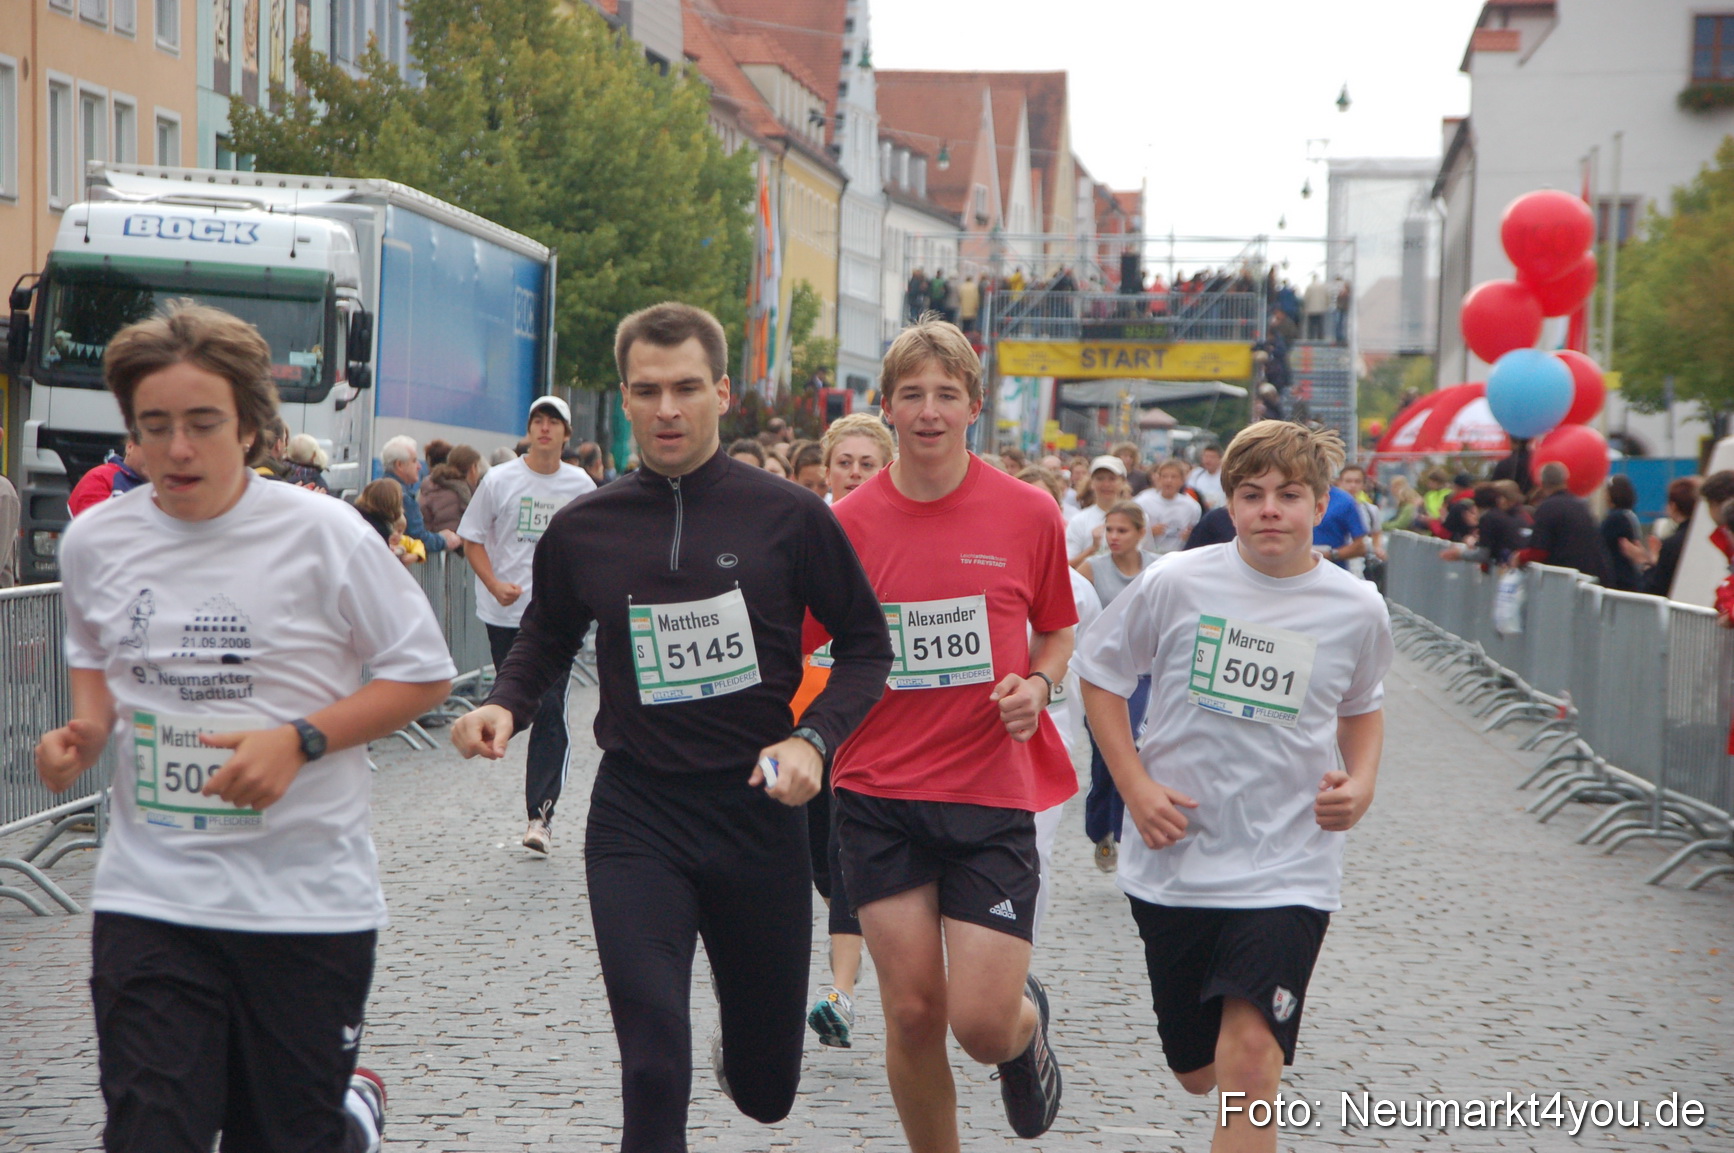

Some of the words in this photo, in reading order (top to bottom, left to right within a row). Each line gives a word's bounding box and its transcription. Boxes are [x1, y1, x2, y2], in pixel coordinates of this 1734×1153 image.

[123, 213, 261, 245] BOCK
[1081, 347, 1169, 369] START
[658, 611, 720, 632] Matthes
[908, 606, 976, 627] Alexander
[181, 636, 252, 649] 21.09.2008
[913, 631, 980, 661] 5180
[1228, 627, 1275, 654] Marco
[637, 645, 645, 659] S
[667, 632, 744, 670] 5145
[1196, 649, 1205, 663] S
[158, 671, 253, 687] Neumarkter
[713, 670, 758, 690] PFLEIDERER
[951, 669, 991, 681] PFLEIDERER
[1222, 658, 1296, 696] 5091
[179, 683, 253, 701] Stadtlauf
[1255, 707, 1297, 721] PFLEIDERER
[990, 907, 1017, 920] adidas
